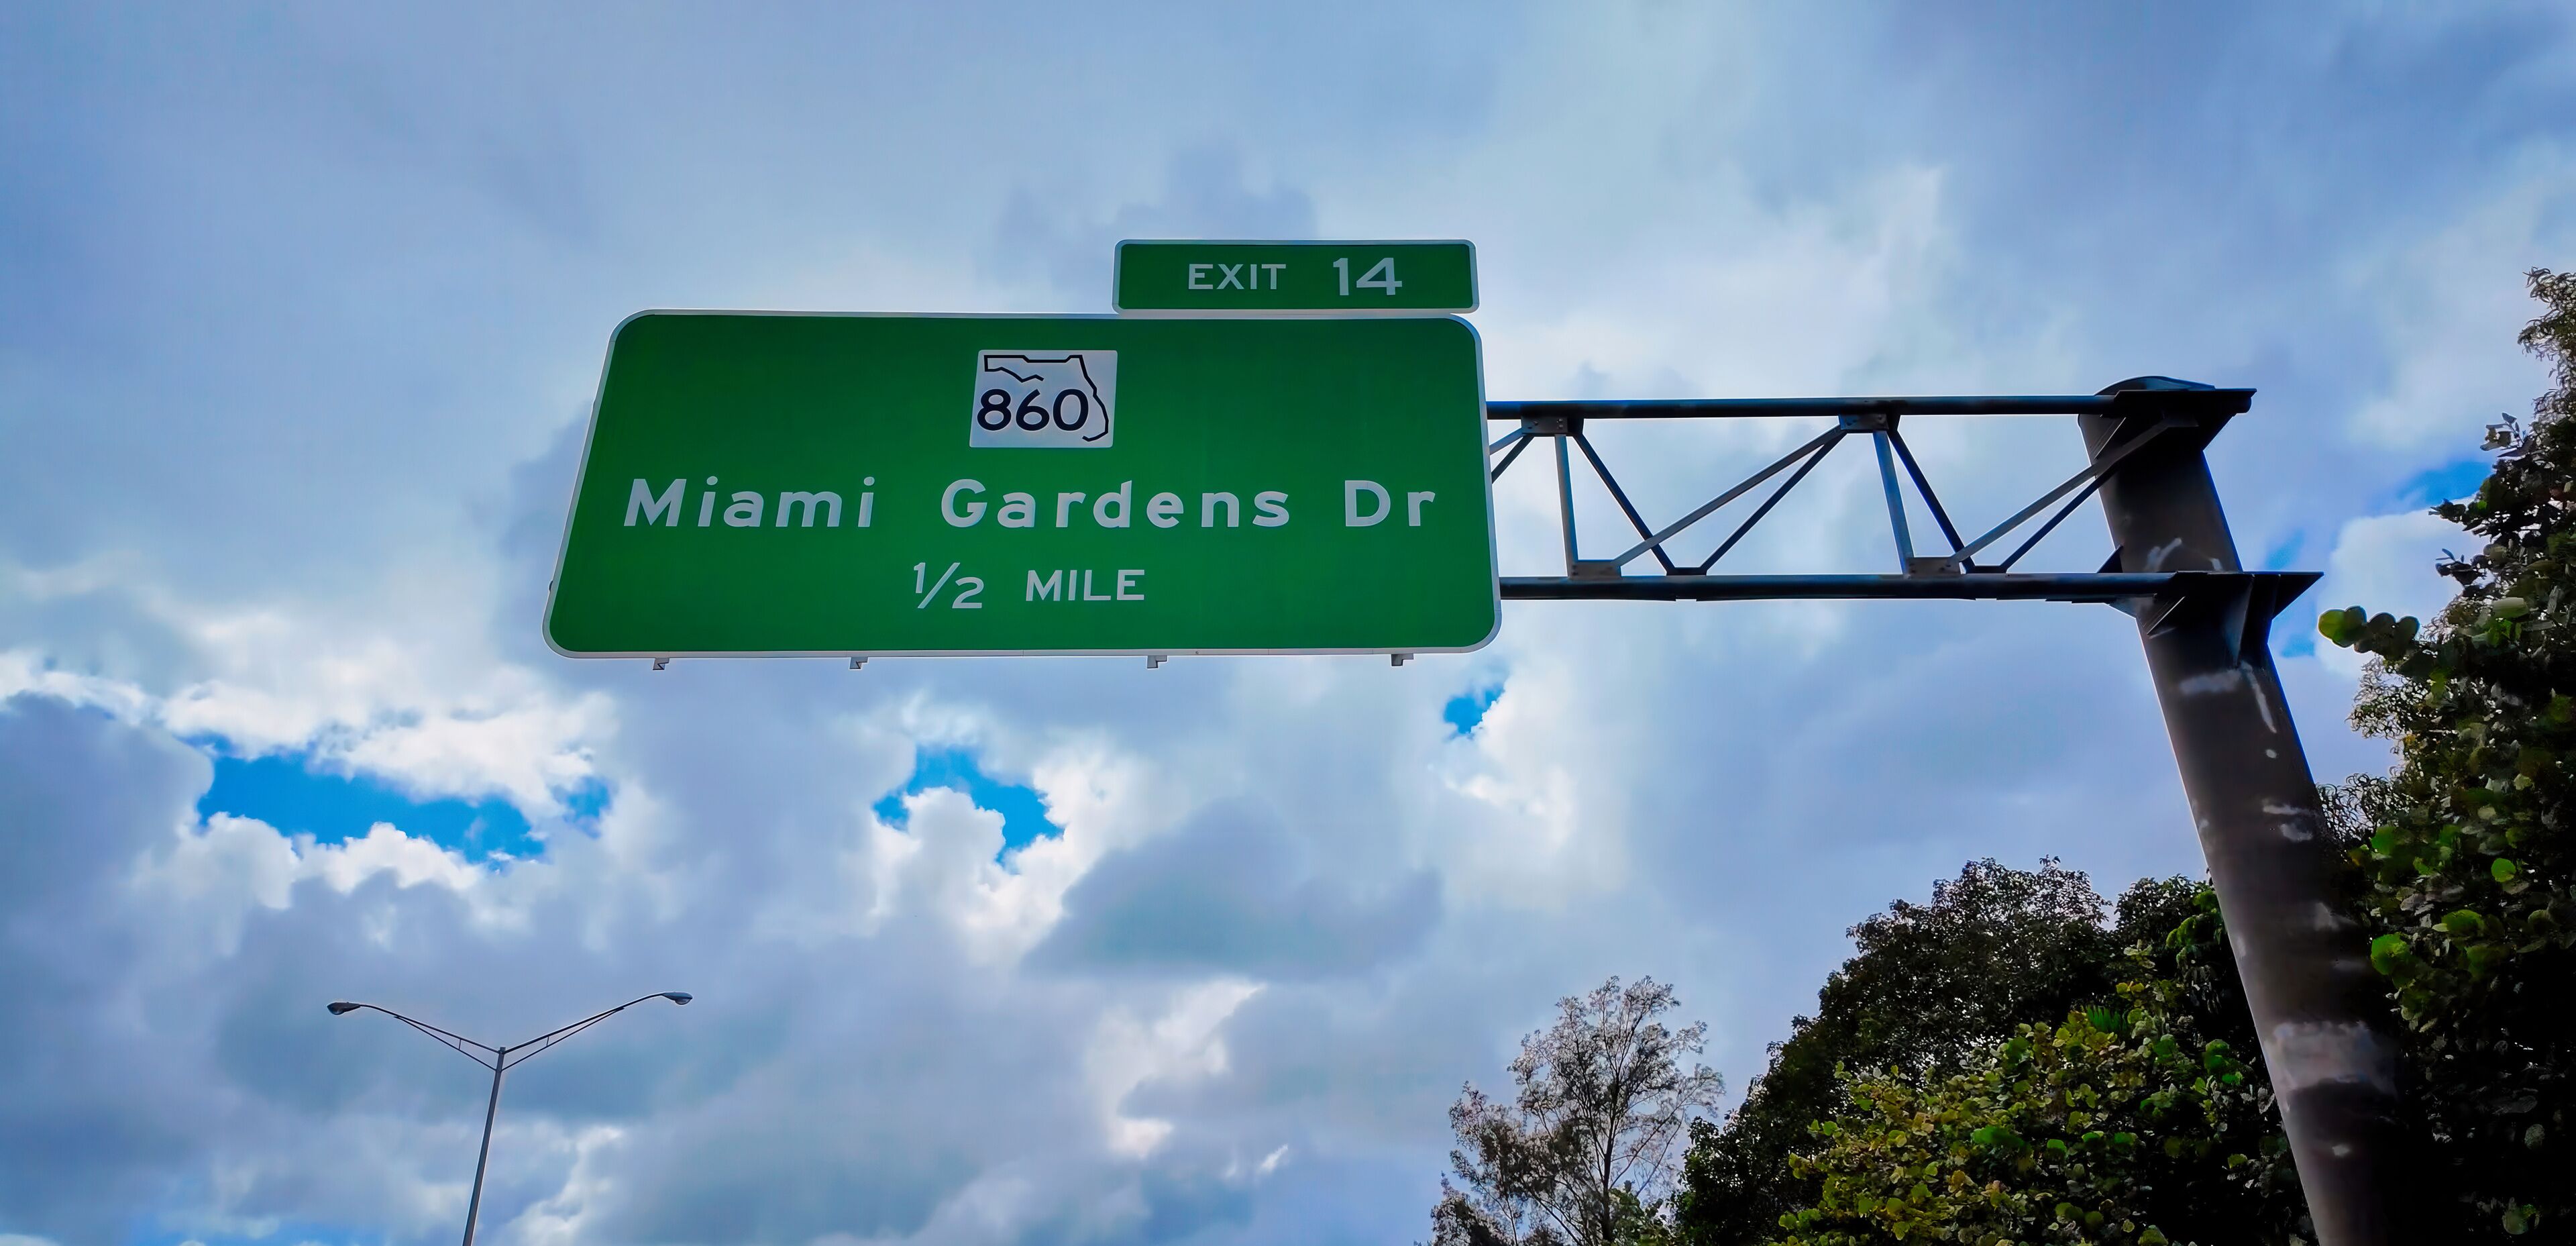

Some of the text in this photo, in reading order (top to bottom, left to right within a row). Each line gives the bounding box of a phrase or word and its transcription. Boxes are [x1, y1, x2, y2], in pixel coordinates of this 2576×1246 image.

[1188, 257, 1402, 297] EXIT 14
[977, 388, 1089, 431] 860
[623, 475, 1436, 529] Miami Gardens Dr
[1026, 569, 1146, 601] MILE
